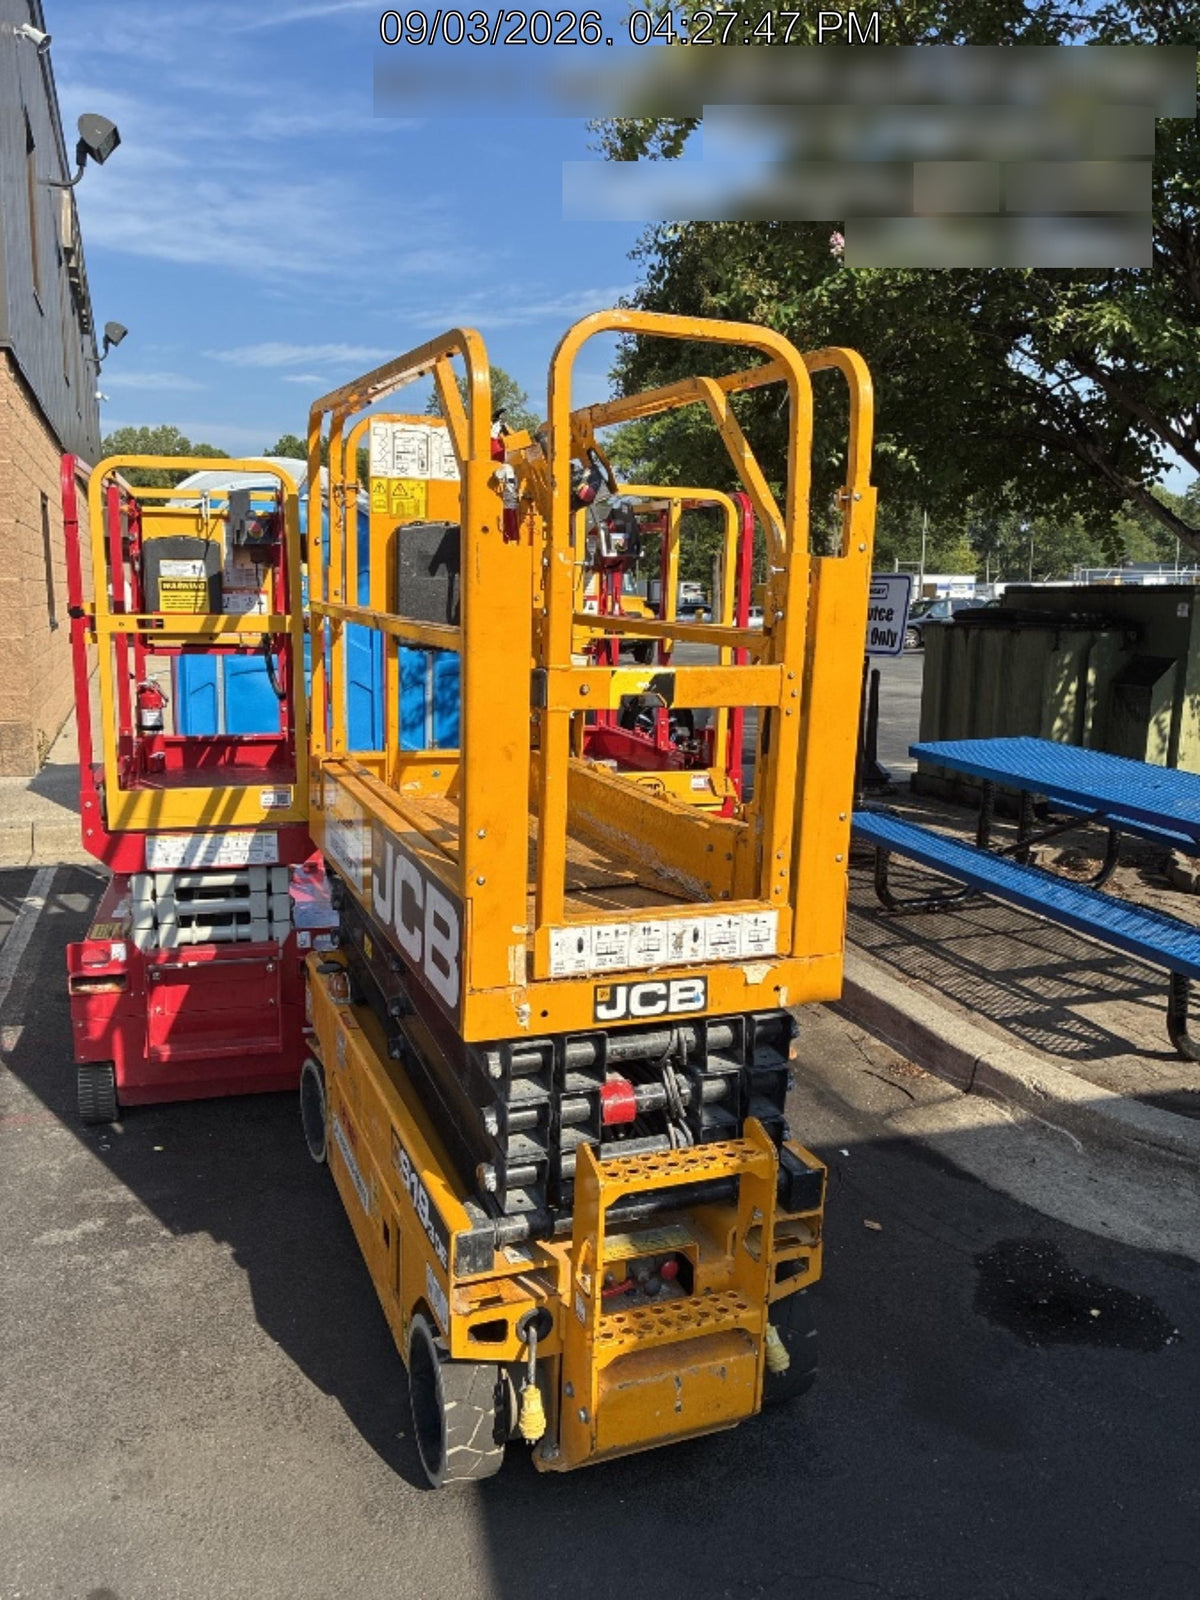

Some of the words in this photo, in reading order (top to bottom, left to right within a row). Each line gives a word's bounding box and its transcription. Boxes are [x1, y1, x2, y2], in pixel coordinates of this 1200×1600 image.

[162, 582, 205, 590] WARNING
[870, 627, 898, 648] Only
[373, 841, 460, 1008] JCB
[596, 979, 705, 1019] JCB
